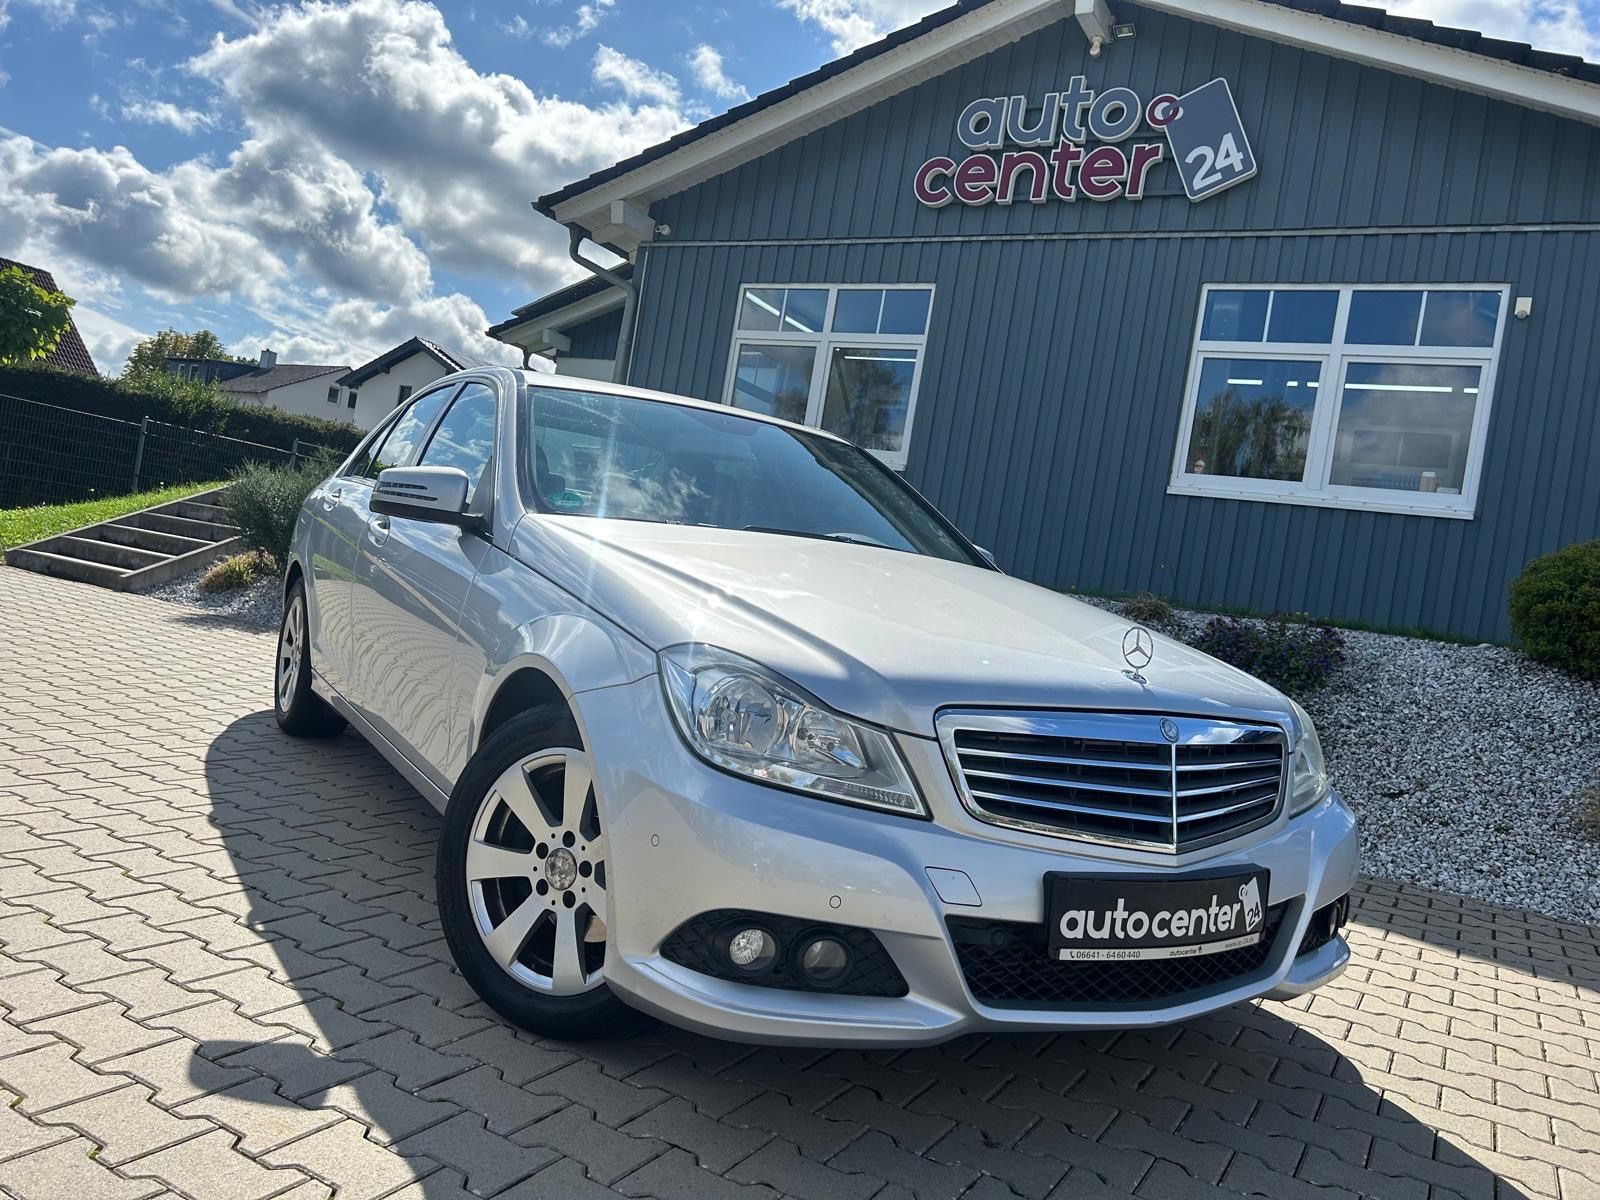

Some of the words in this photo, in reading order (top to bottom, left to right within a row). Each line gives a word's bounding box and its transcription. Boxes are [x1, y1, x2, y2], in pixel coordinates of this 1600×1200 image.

[957, 75, 1142, 149] auto
[914, 136, 1163, 208] center
[1185, 132, 1244, 191] 24
[1246, 904, 1262, 926] 24
